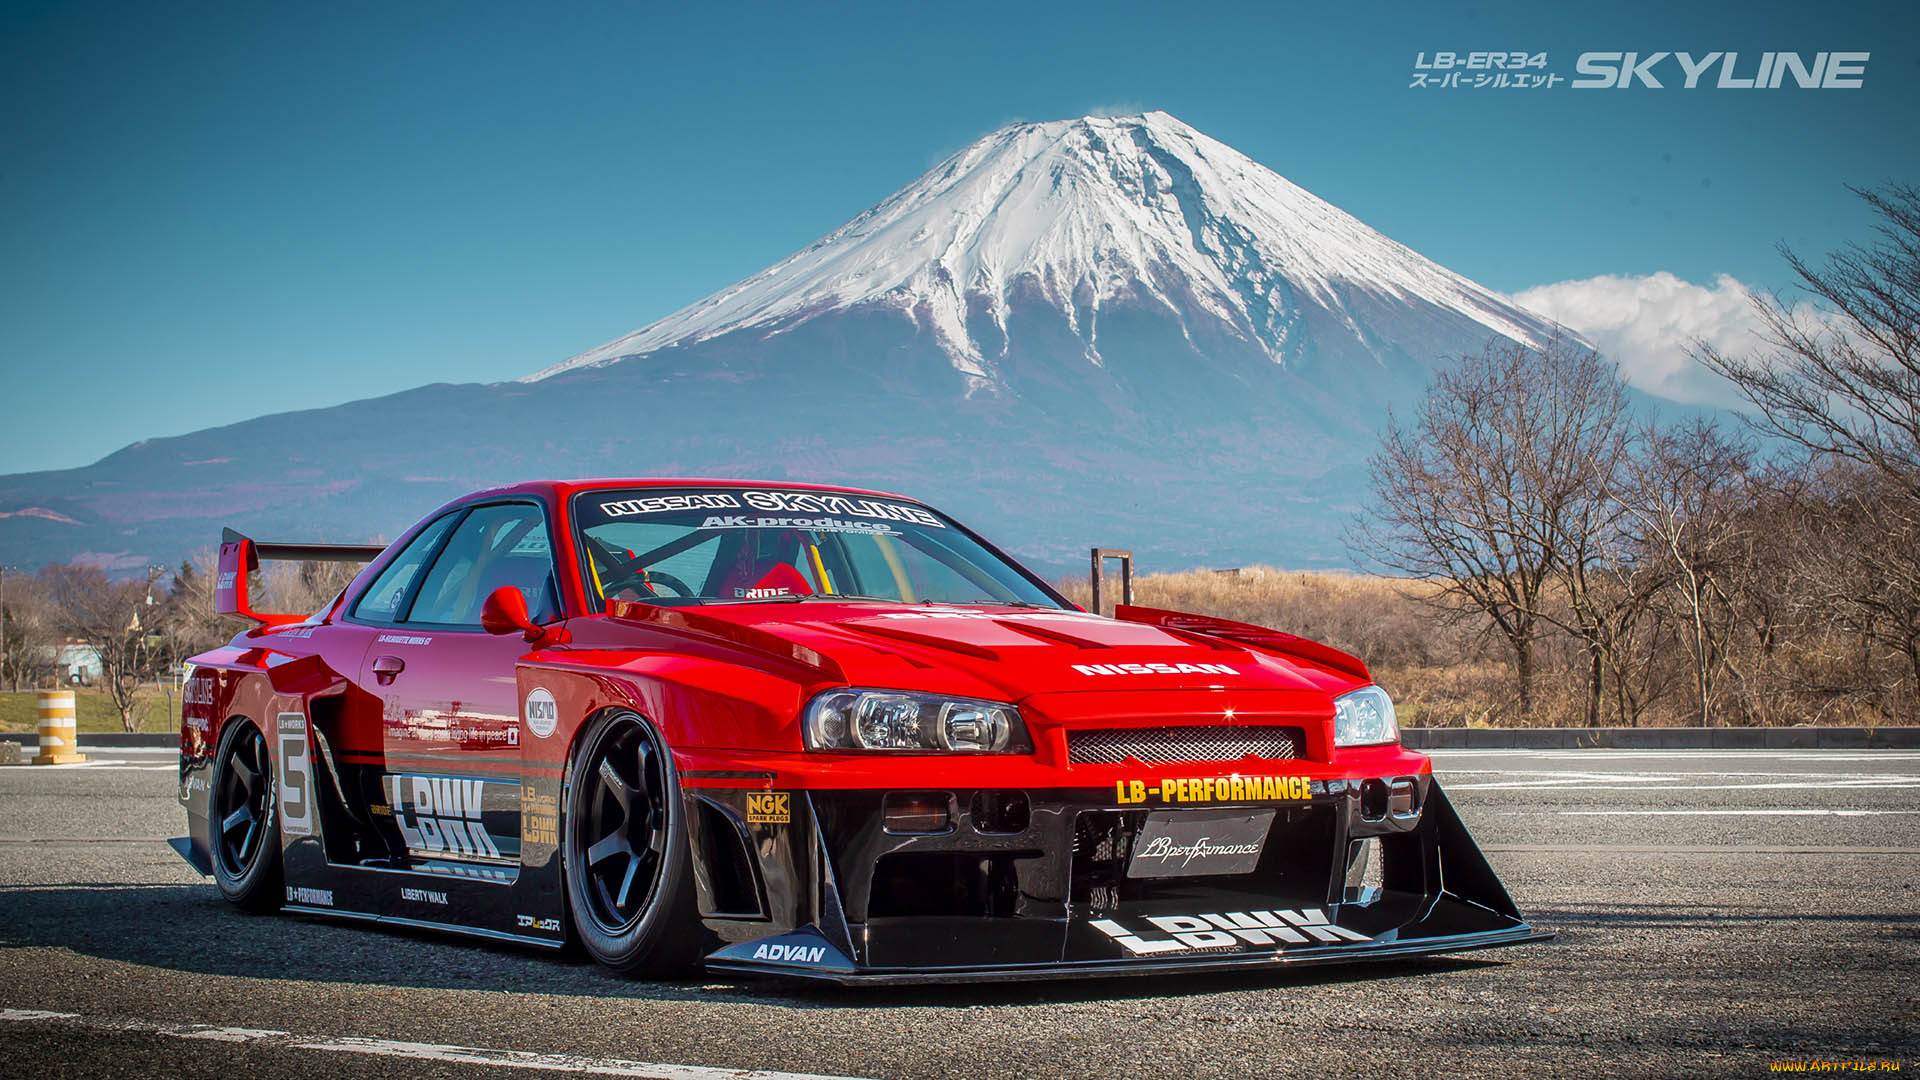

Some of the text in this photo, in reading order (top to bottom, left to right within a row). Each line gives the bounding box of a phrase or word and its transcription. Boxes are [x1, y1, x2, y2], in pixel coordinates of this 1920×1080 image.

[600, 491, 947, 529] NISSAN SKYLINE
[702, 515, 892, 532] AK-produce
[1071, 663, 1240, 676] NISSAN
[283, 739, 306, 819] 5
[1116, 776, 1313, 804] LB-PERFORMANCE
[748, 794, 788, 815] NGK
[401, 887, 449, 905] LIBERTY WALK
[752, 943, 826, 963] ADVAN
